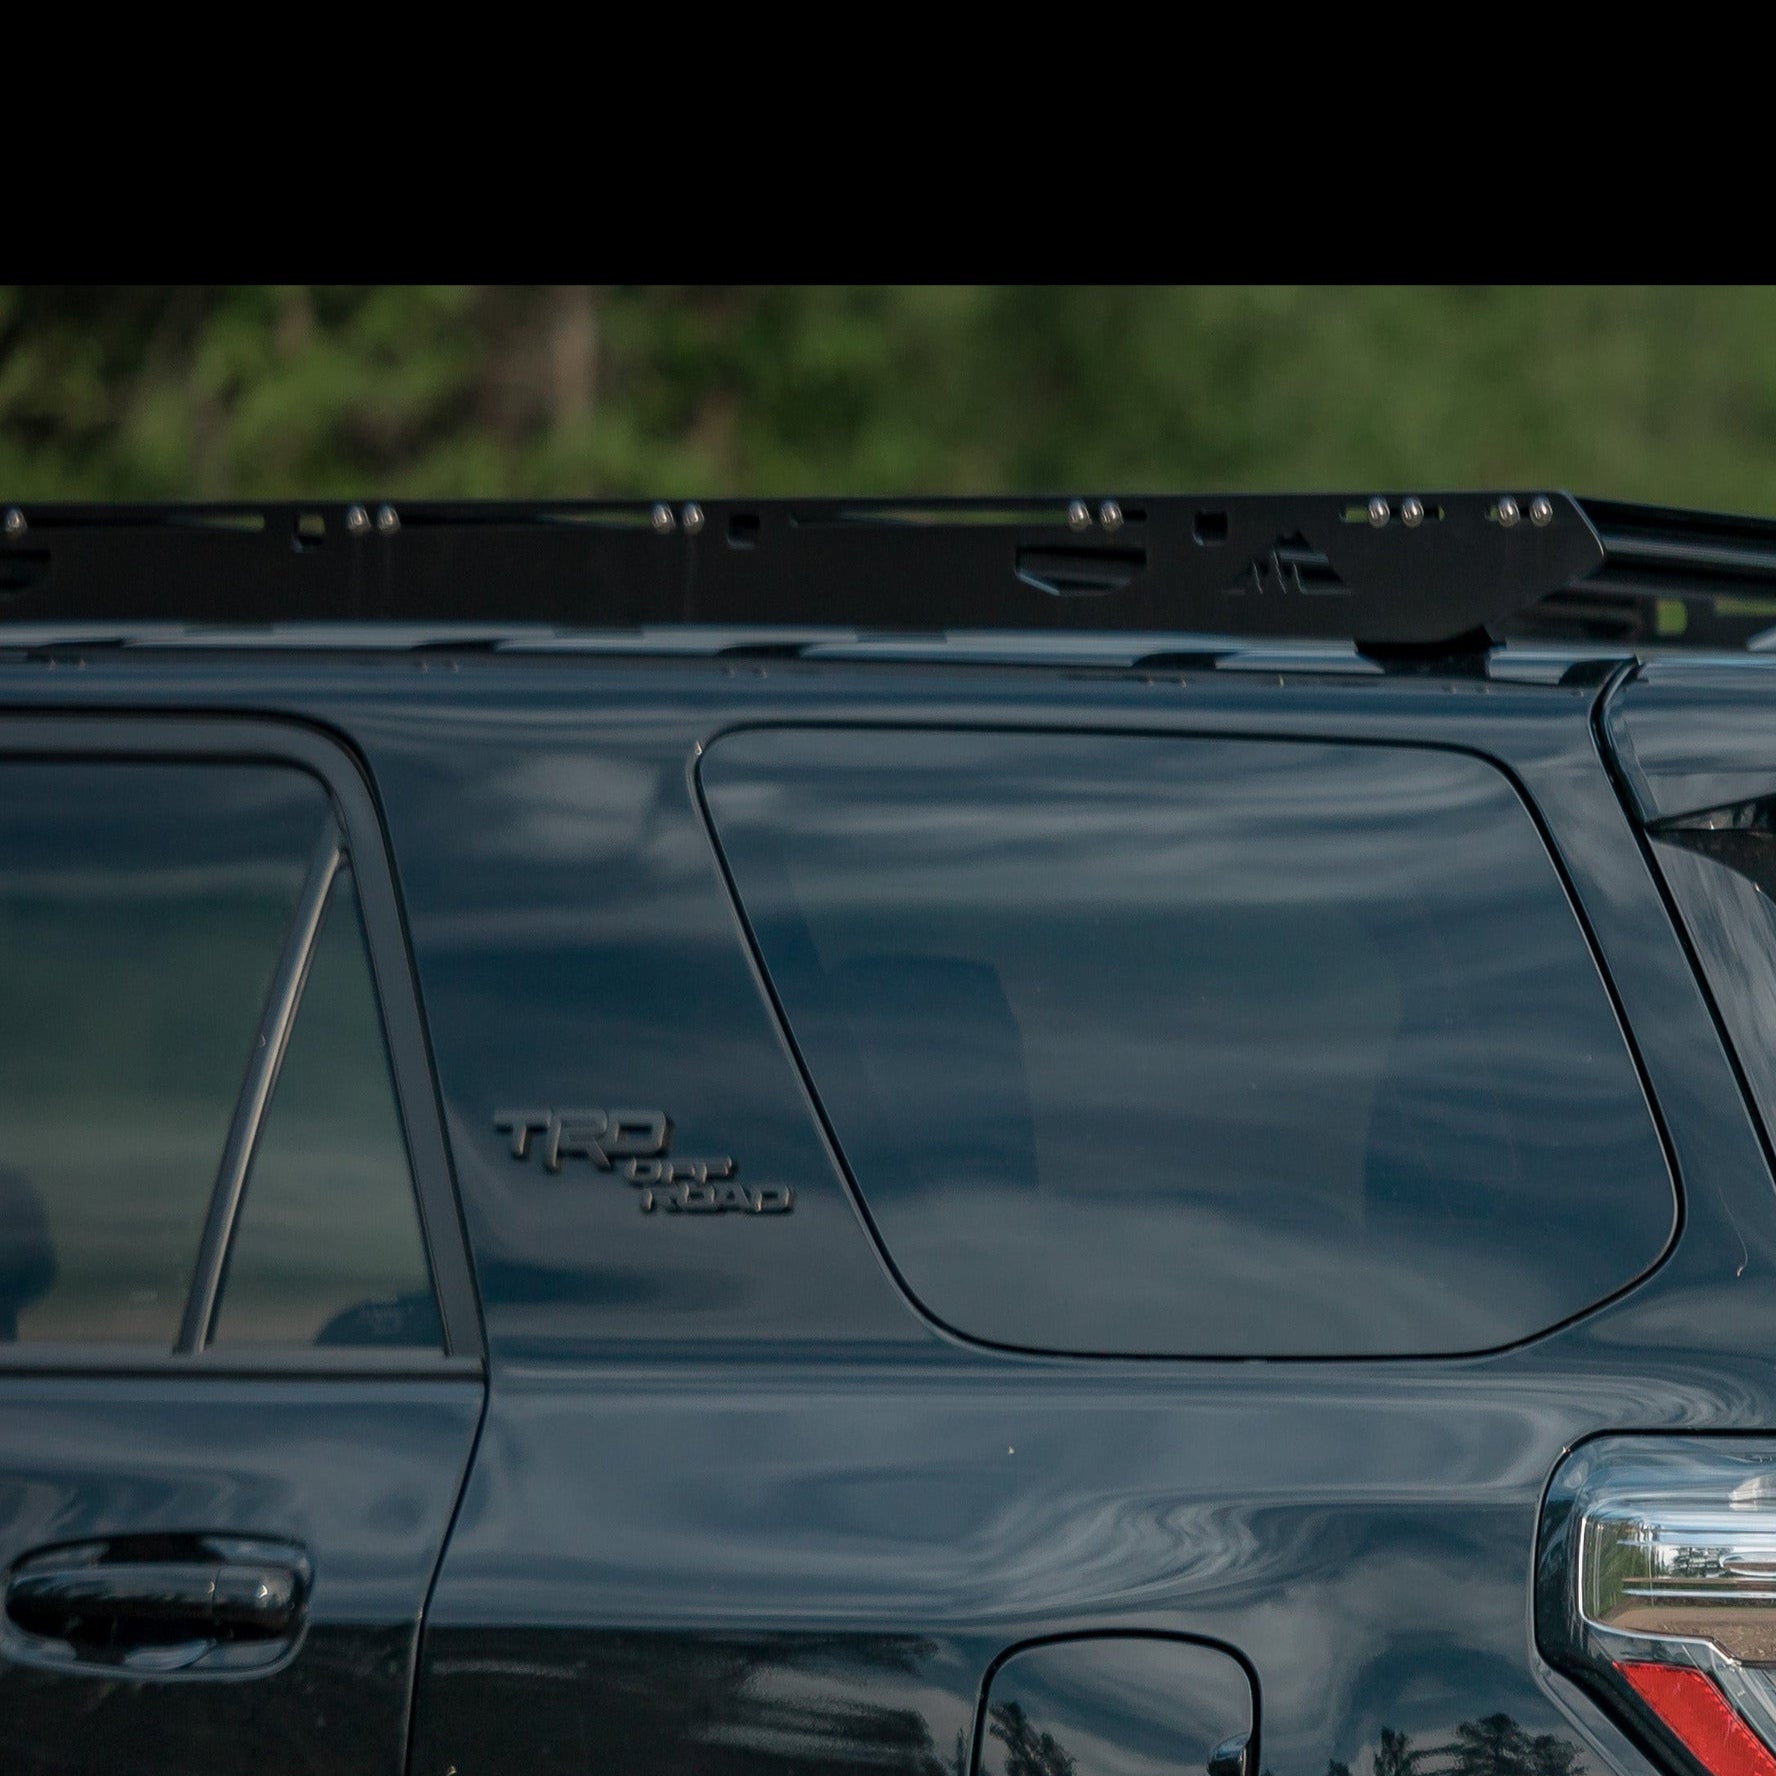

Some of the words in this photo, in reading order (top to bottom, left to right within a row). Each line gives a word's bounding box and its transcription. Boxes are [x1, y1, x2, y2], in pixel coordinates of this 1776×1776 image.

[495, 1108, 673, 1172] TRD
[627, 1155, 737, 1186] OFF
[642, 1183, 796, 1215] ROAD
